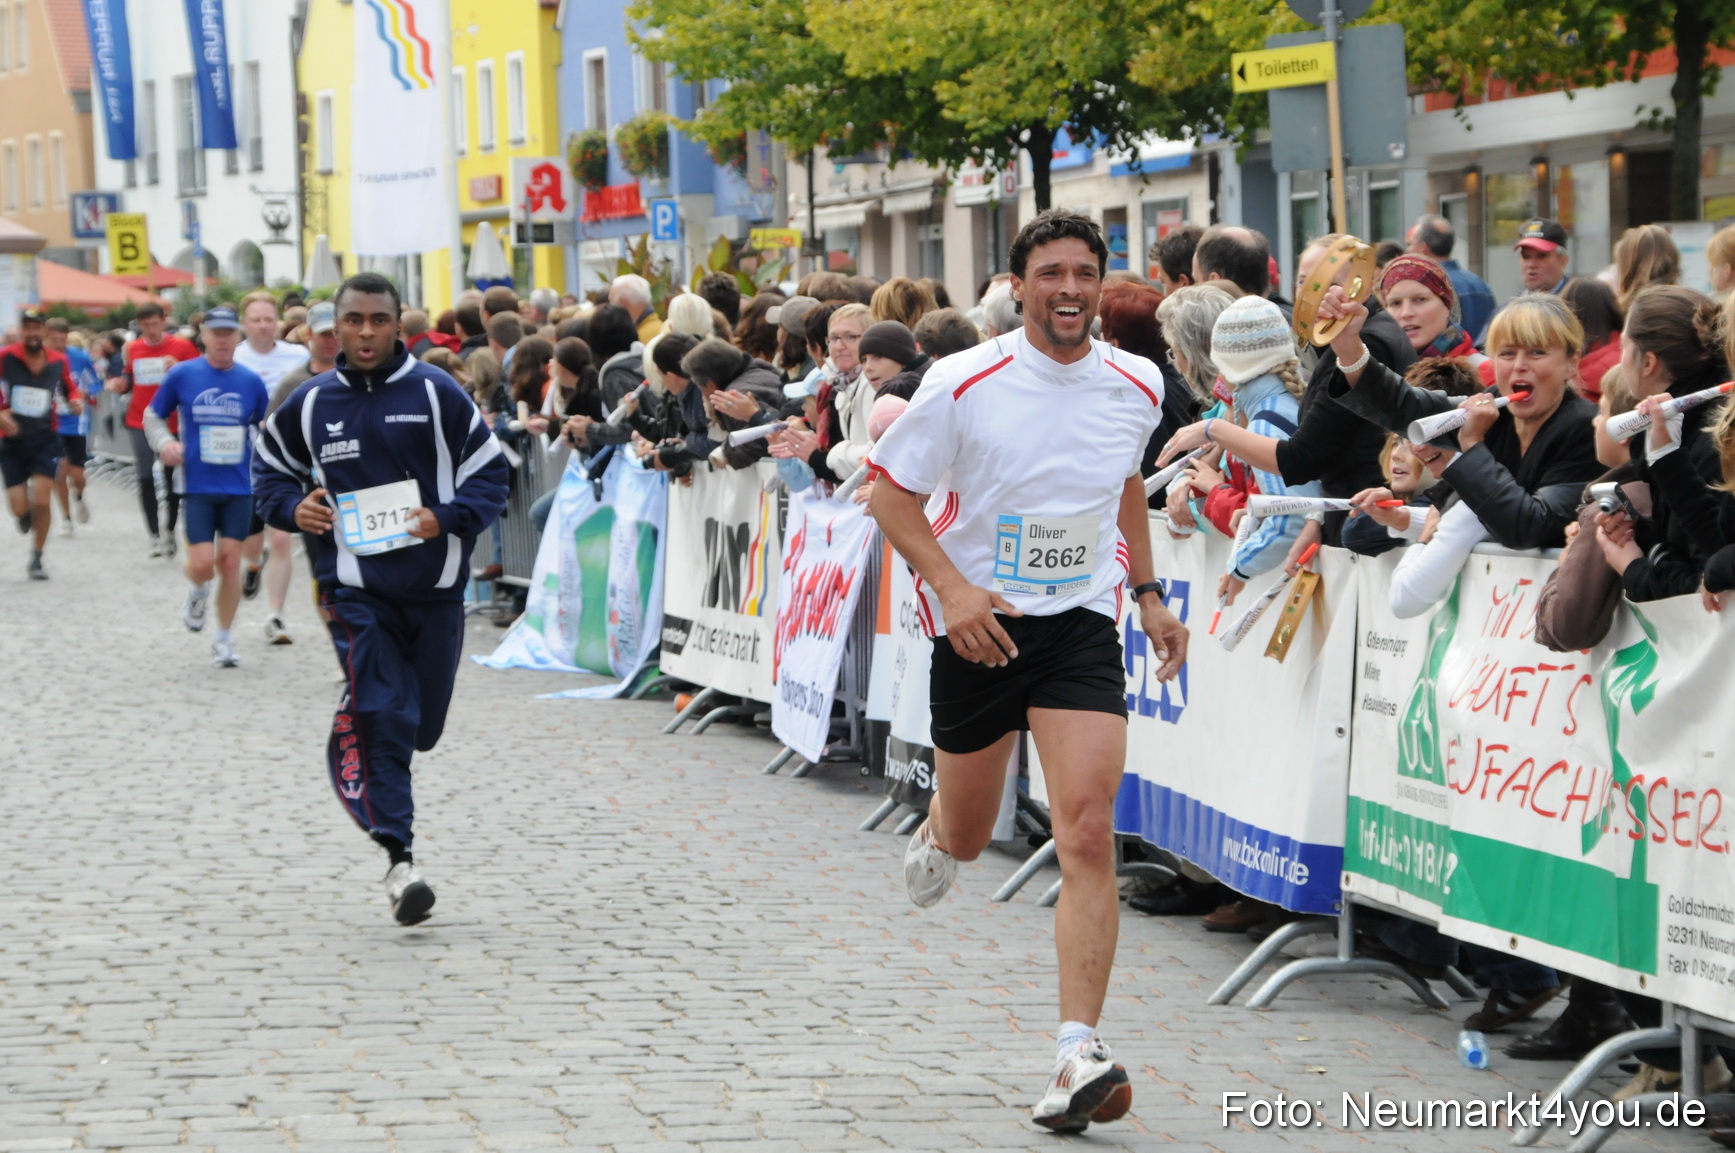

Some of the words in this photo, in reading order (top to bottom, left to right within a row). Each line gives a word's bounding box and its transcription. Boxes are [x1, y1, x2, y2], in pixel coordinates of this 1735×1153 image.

[1255, 58, 1319, 78] Toiletten
[656, 204, 674, 237] P
[119, 232, 139, 261] B
[398, 414, 430, 423] NEUMARKT
[320, 438, 360, 458] JURA
[365, 506, 410, 531] 3717
[1029, 524, 1067, 539] Oliver
[1005, 542, 1011, 553] B
[1027, 545, 1087, 569] 2662
[1057, 579, 1091, 592] PFLEIDERER
[1669, 953, 1689, 975] Fax
